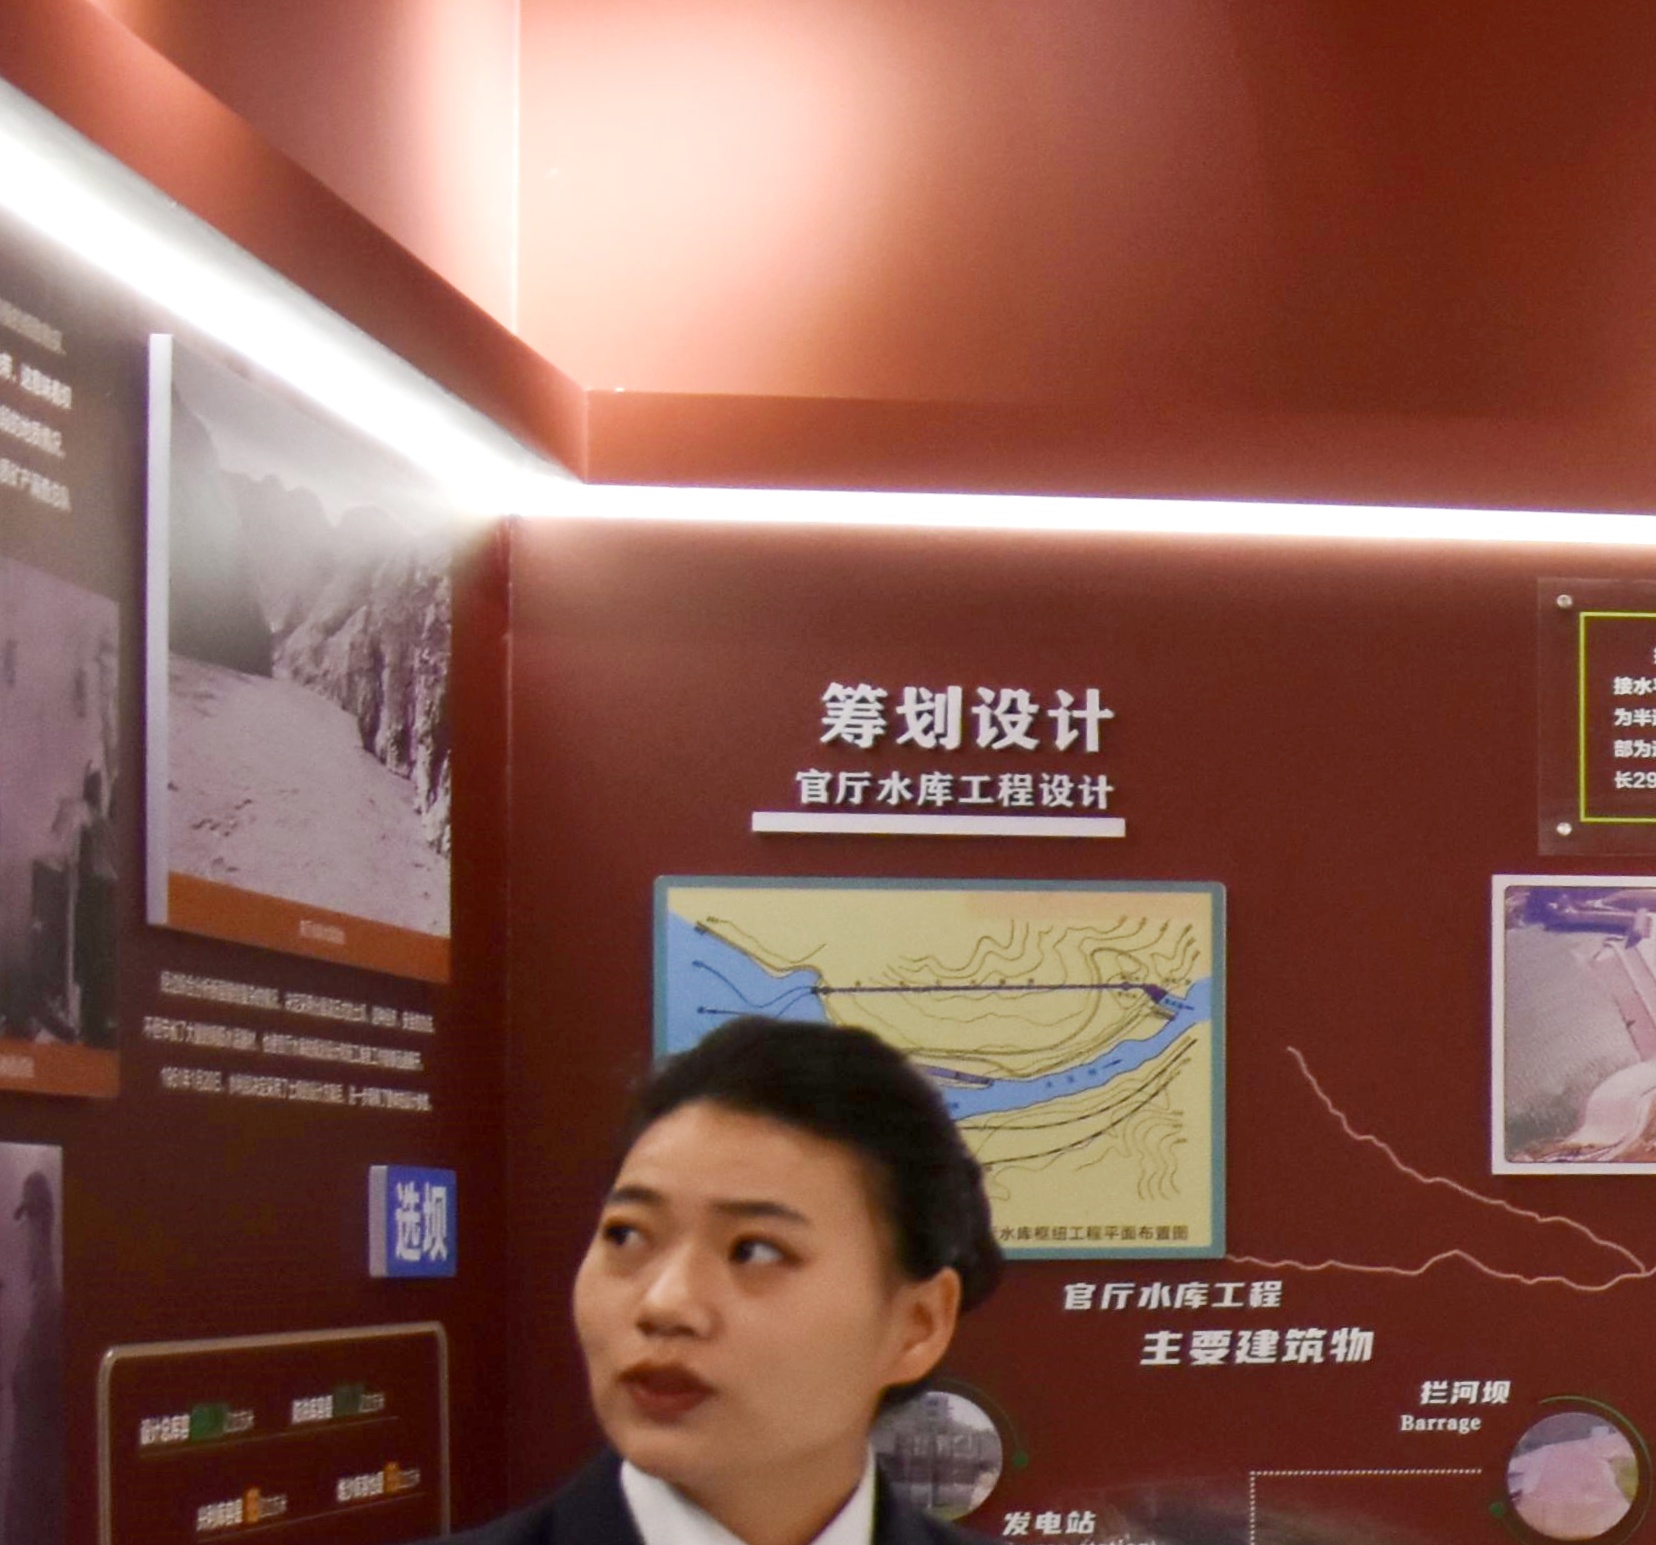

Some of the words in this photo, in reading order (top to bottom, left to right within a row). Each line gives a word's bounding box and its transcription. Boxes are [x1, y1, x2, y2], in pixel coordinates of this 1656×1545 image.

[819, 680, 1115, 753] 筹划设计
[795, 768, 1115, 810] 官厅水库工程设计
[393, 1180, 449, 1263] 选坝
[1062, 1279, 1285, 1312] 官厅水库工程
[1139, 1325, 1376, 1368] 主要建筑物
[1419, 1379, 1511, 1408] 拦河坝
[1400, 1413, 1483, 1435] Barrage
[1002, 1510, 1097, 1537] 发电站
